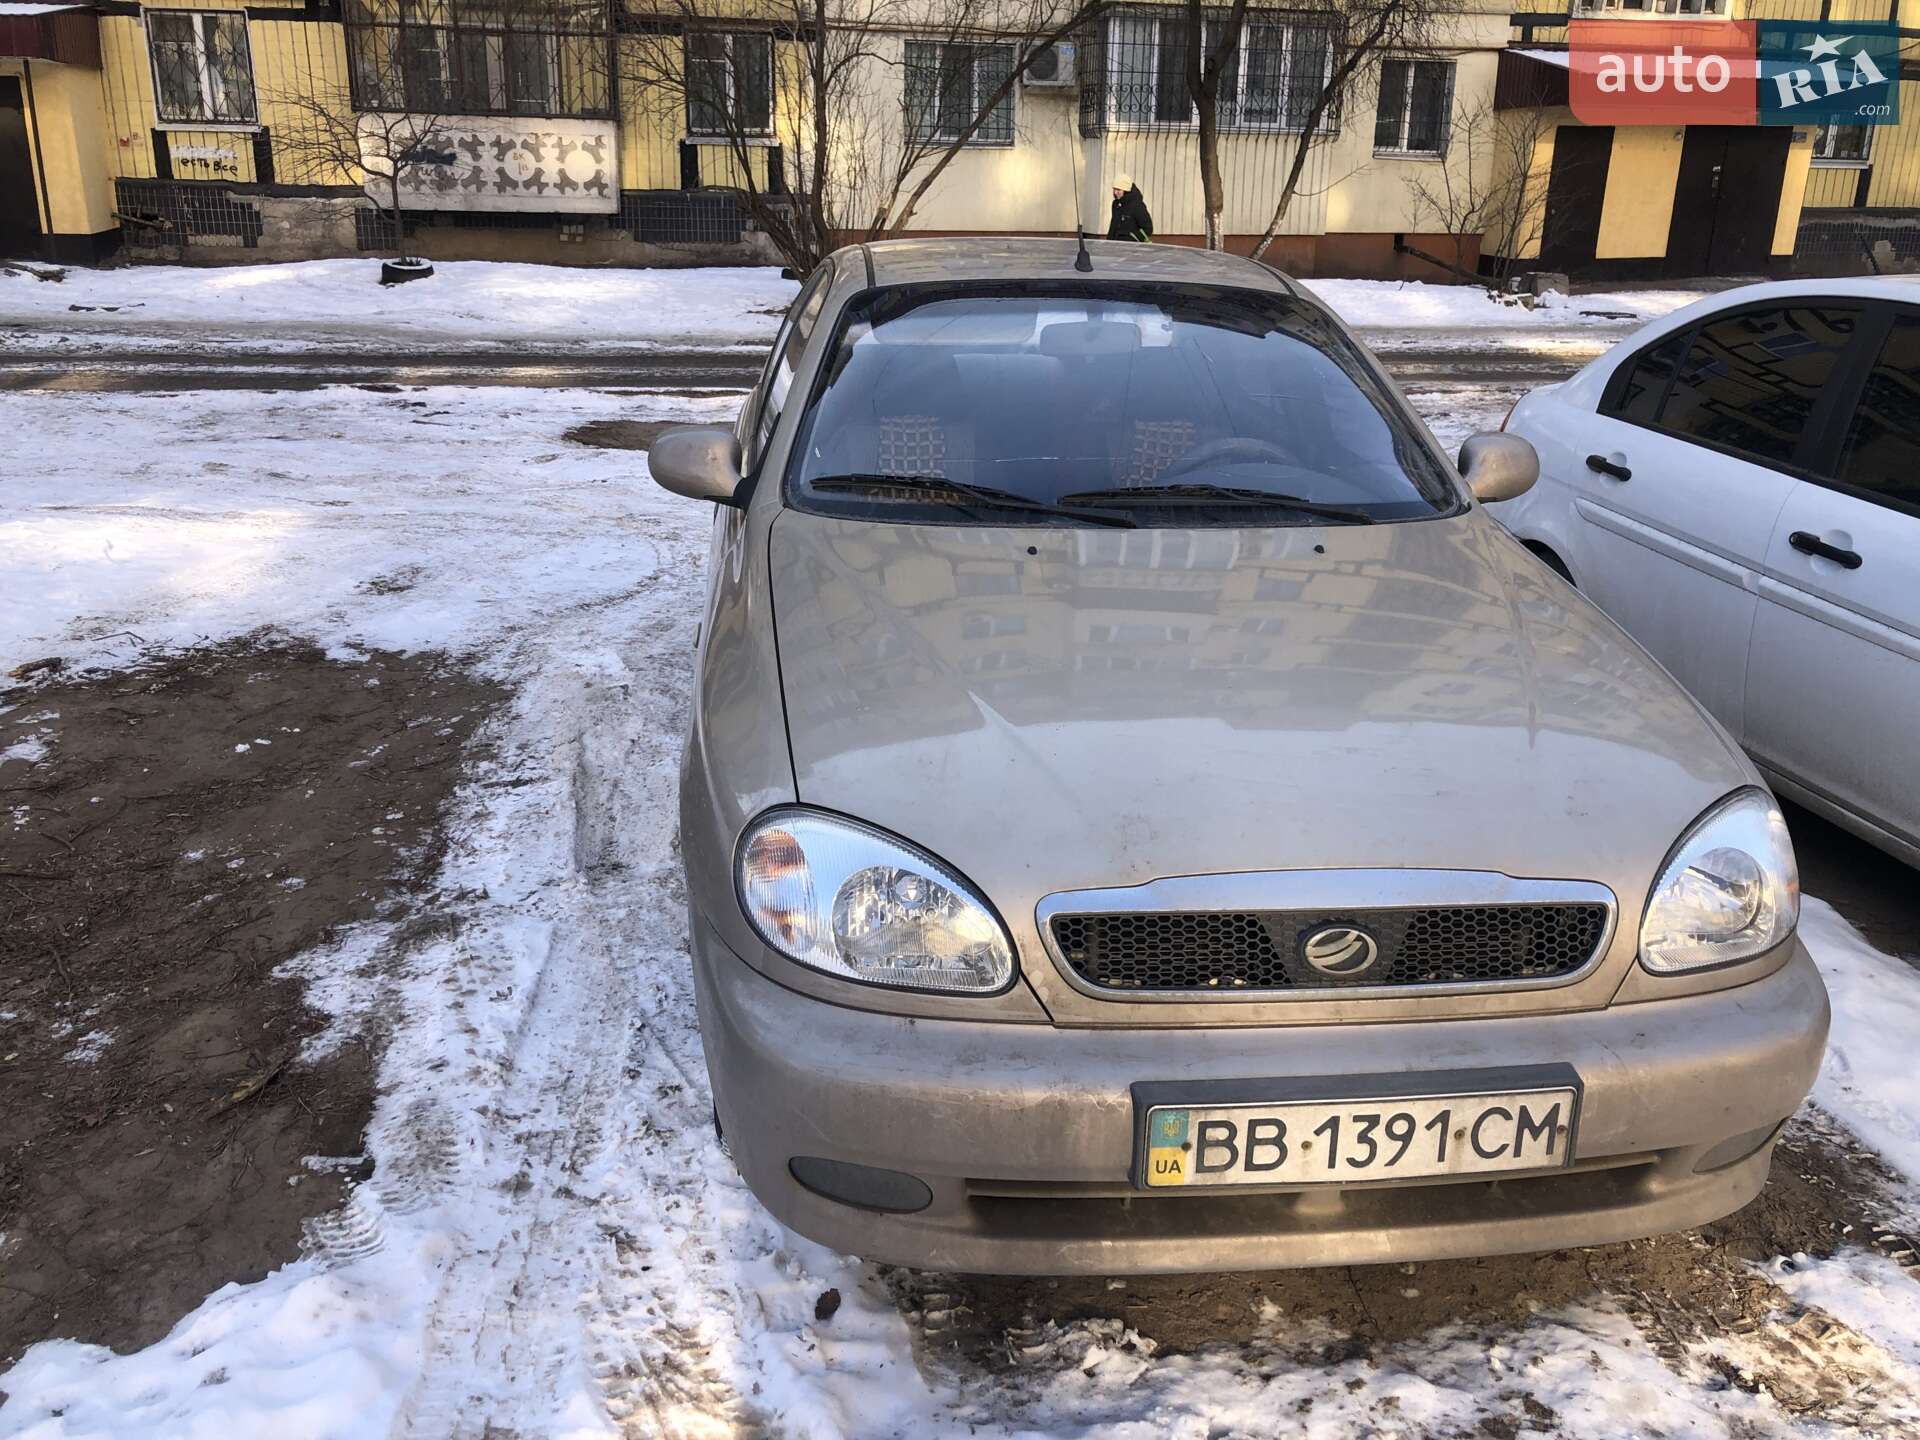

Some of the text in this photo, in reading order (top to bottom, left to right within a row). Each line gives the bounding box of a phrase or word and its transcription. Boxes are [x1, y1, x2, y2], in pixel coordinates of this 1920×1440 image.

[1195, 1102, 1561, 1174] BB 1391 CM
[1155, 1159, 1182, 1175] UA
